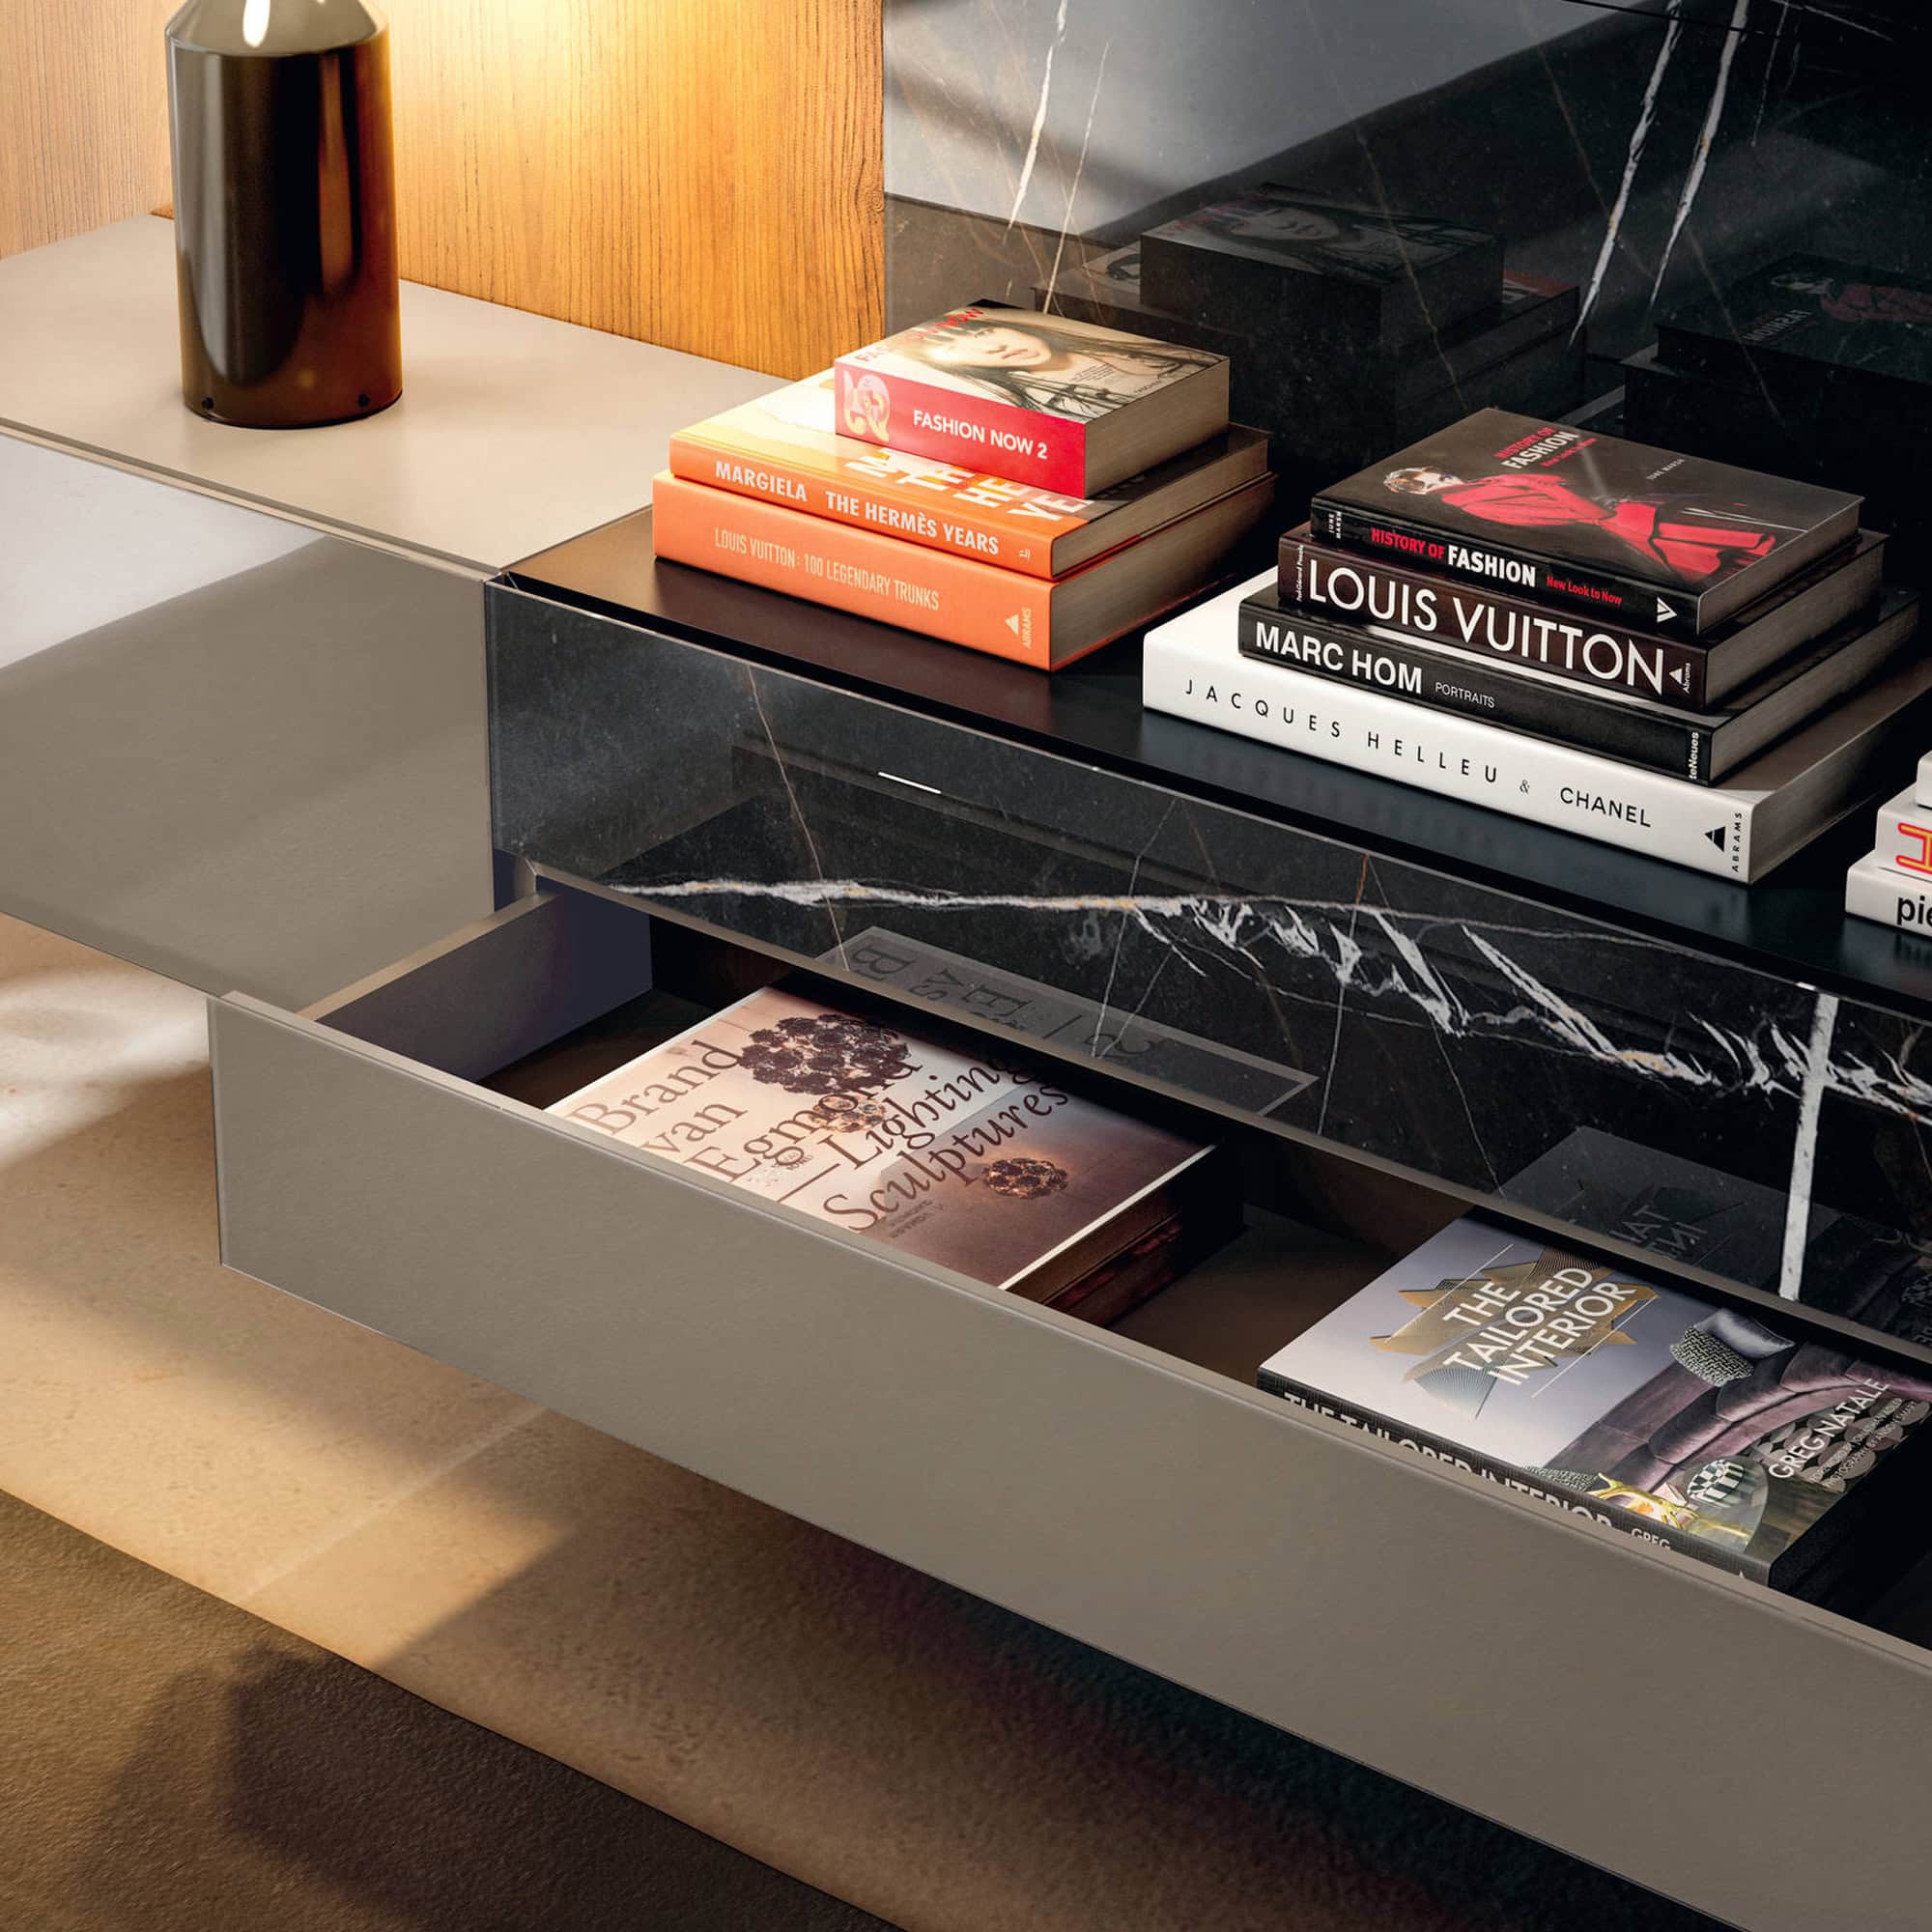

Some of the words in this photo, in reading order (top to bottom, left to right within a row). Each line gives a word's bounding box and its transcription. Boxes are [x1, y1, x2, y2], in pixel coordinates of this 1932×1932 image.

[913, 410, 985, 443] FASHION
[990, 429, 1034, 456] NOW
[1037, 442, 1048, 460] 2
[1501, 431, 1580, 469] FASHION
[715, 460, 808, 502] MARGIELA
[825, 491, 860, 516] THE
[865, 501, 938, 538] HERMÈS
[943, 523, 999, 555] YEARS
[715, 526, 748, 555] LOUIS
[804, 554, 824, 577] 100
[826, 559, 892, 596] LEGENDARY
[894, 580, 940, 611] TRUNKS
[1371, 527, 1427, 554] HISTORY
[1428, 543, 1445, 560] OF
[1448, 544, 1536, 587] FASHION
[1547, 575, 1566, 590] New
[1568, 582, 1589, 597] Look
[1591, 588, 1601, 601] to
[1601, 591, 1622, 606] Now
[1256, 621, 1345, 671] MARC
[1352, 648, 1423, 695] HOM
[1435, 681, 1495, 709] PORTRAITS
[1310, 558, 1437, 634] LOUIS
[1454, 596, 1663, 696] VUITTON
[1185, 679, 1341, 738] JACQUES
[1367, 731, 1497, 783] HELLEU
[1520, 779, 1530, 795] &
[1560, 786, 1652, 828] CHANEL
[1689, 731, 1700, 780] teNeues
[1731, 811, 1743, 872] ABRAMS
[563, 1039, 743, 1136] Brand
[640, 1100, 749, 1153] van
[823, 1084, 1068, 1232] Sculptures
[1442, 1281, 1521, 1325] THE
[1442, 1267, 1594, 1371] TAILORED
[1487, 1281, 1638, 1386] INTERIOR
[1769, 1435, 1826, 1480] GREG
[1814, 1378, 1891, 1438] NATALE
